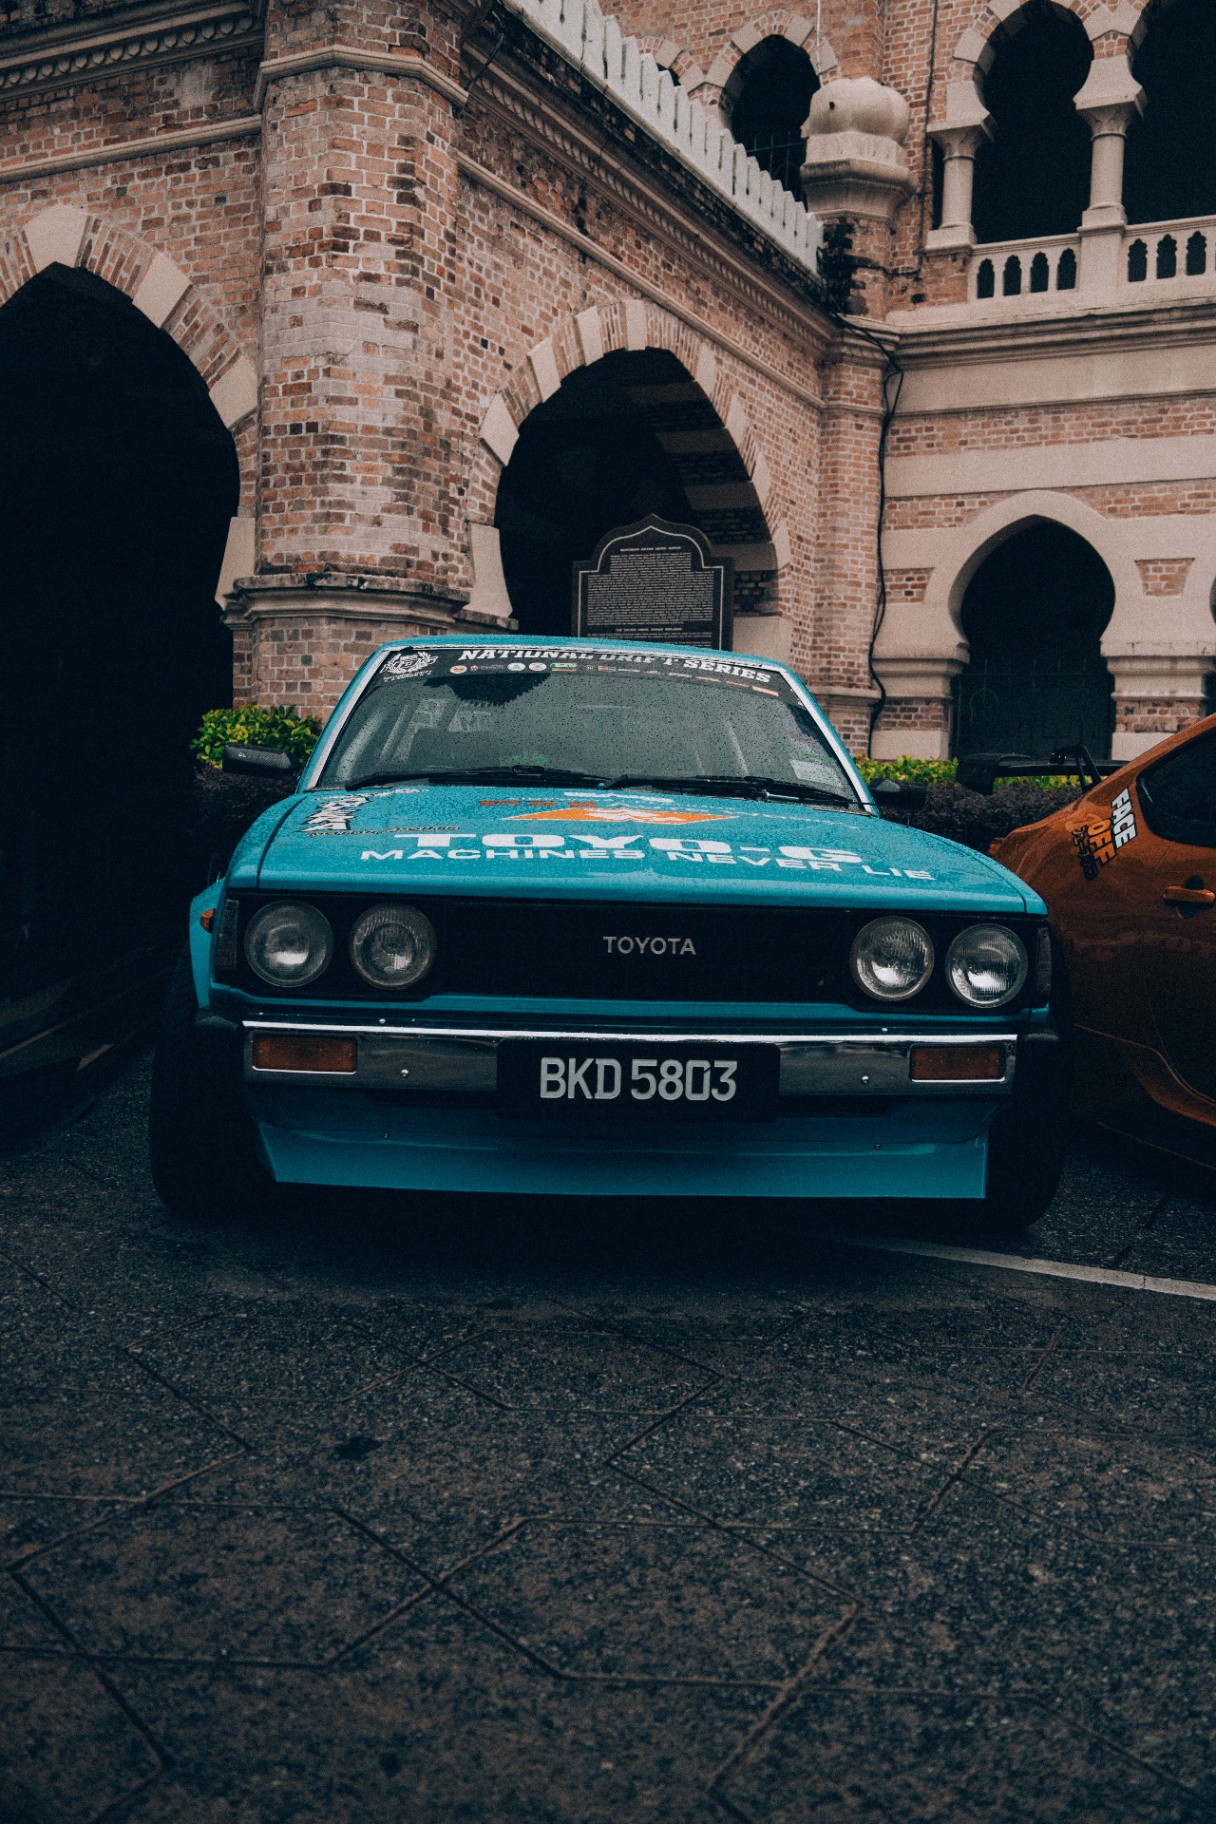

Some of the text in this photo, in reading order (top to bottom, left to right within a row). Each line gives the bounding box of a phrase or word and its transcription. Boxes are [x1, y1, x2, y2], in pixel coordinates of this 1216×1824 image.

[683, 659, 771, 683] SERIES
[1112, 787, 1137, 849] FACE
[1087, 818, 1117, 866] OFF
[360, 849, 936, 881] MACHINES NEVER LIE
[603, 936, 696, 955] TOYOTA
[540, 1057, 738, 1101] BKD 5803
